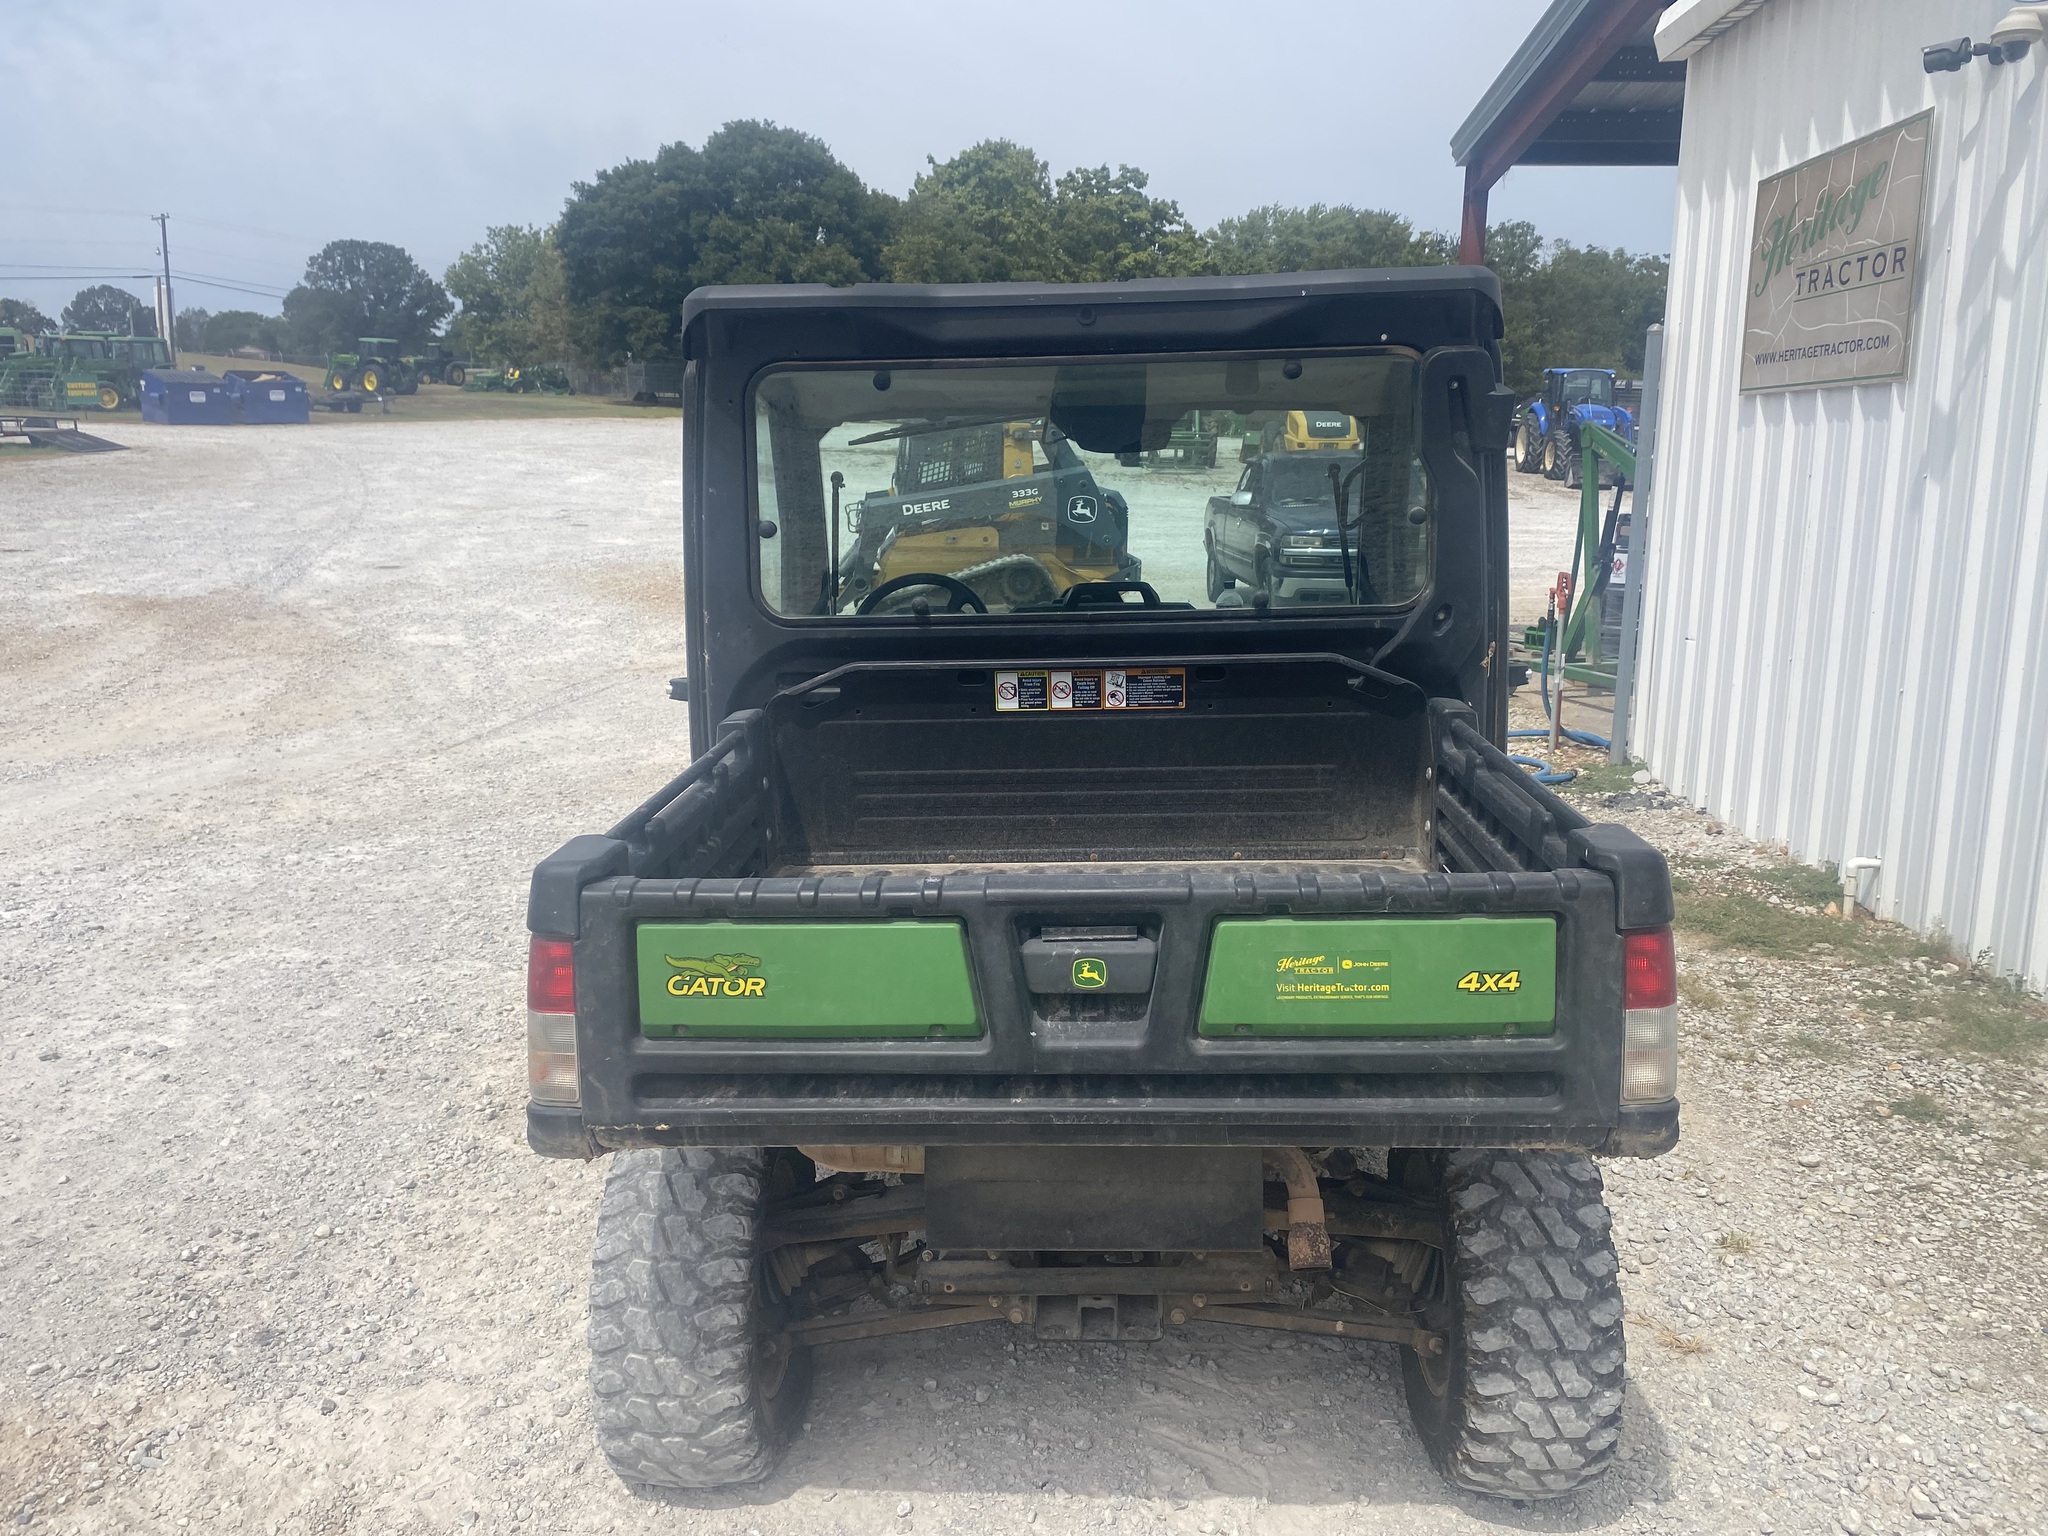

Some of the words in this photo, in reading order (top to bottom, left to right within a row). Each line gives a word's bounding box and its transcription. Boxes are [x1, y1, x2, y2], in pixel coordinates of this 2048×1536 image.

[1755, 161, 1889, 298] Heritage
[1795, 246, 1907, 296] TRACTOR
[1754, 334, 1890, 367] WWW.HERITAGETRACTOR.COM
[1011, 488, 1039, 499] 333G
[901, 499, 951, 516] DEERE
[1276, 955, 1326, 973] Heritage
[666, 974, 767, 997] GATOR
[1276, 983, 1295, 992] Visit
[1297, 982, 1390, 995] HeritageTractor.com
